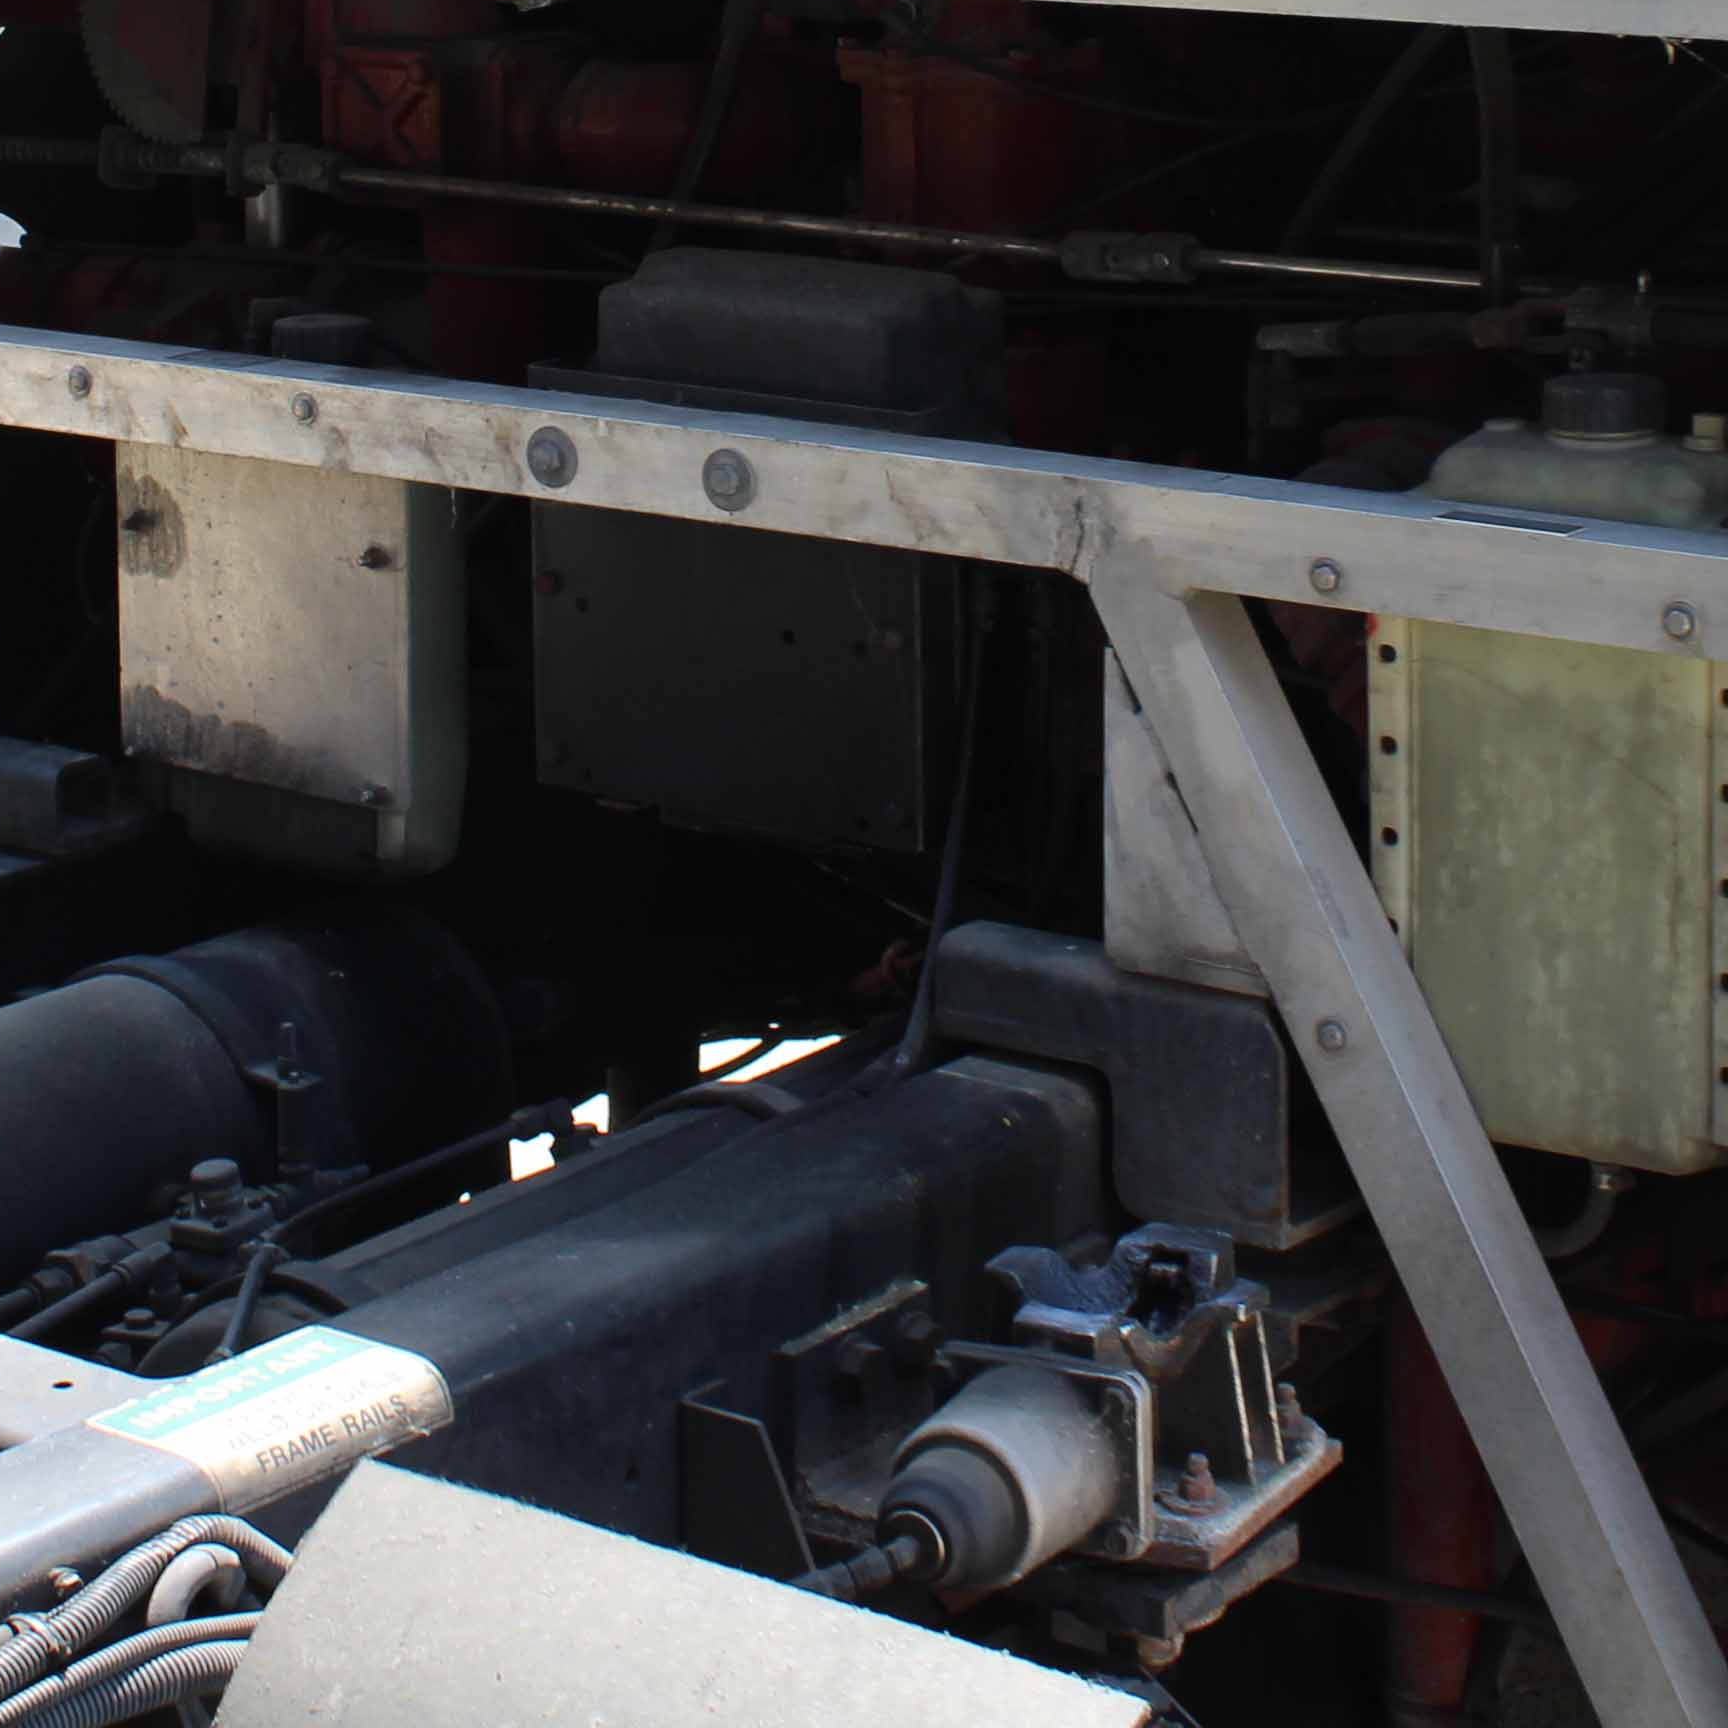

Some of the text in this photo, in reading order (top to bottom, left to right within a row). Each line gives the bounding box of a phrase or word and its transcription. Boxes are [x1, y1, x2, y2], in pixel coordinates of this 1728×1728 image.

[129, 1339, 337, 1429] IMPORTANT
[255, 1424, 338, 1473] FRAME
[341, 1393, 411, 1438] RAILS
